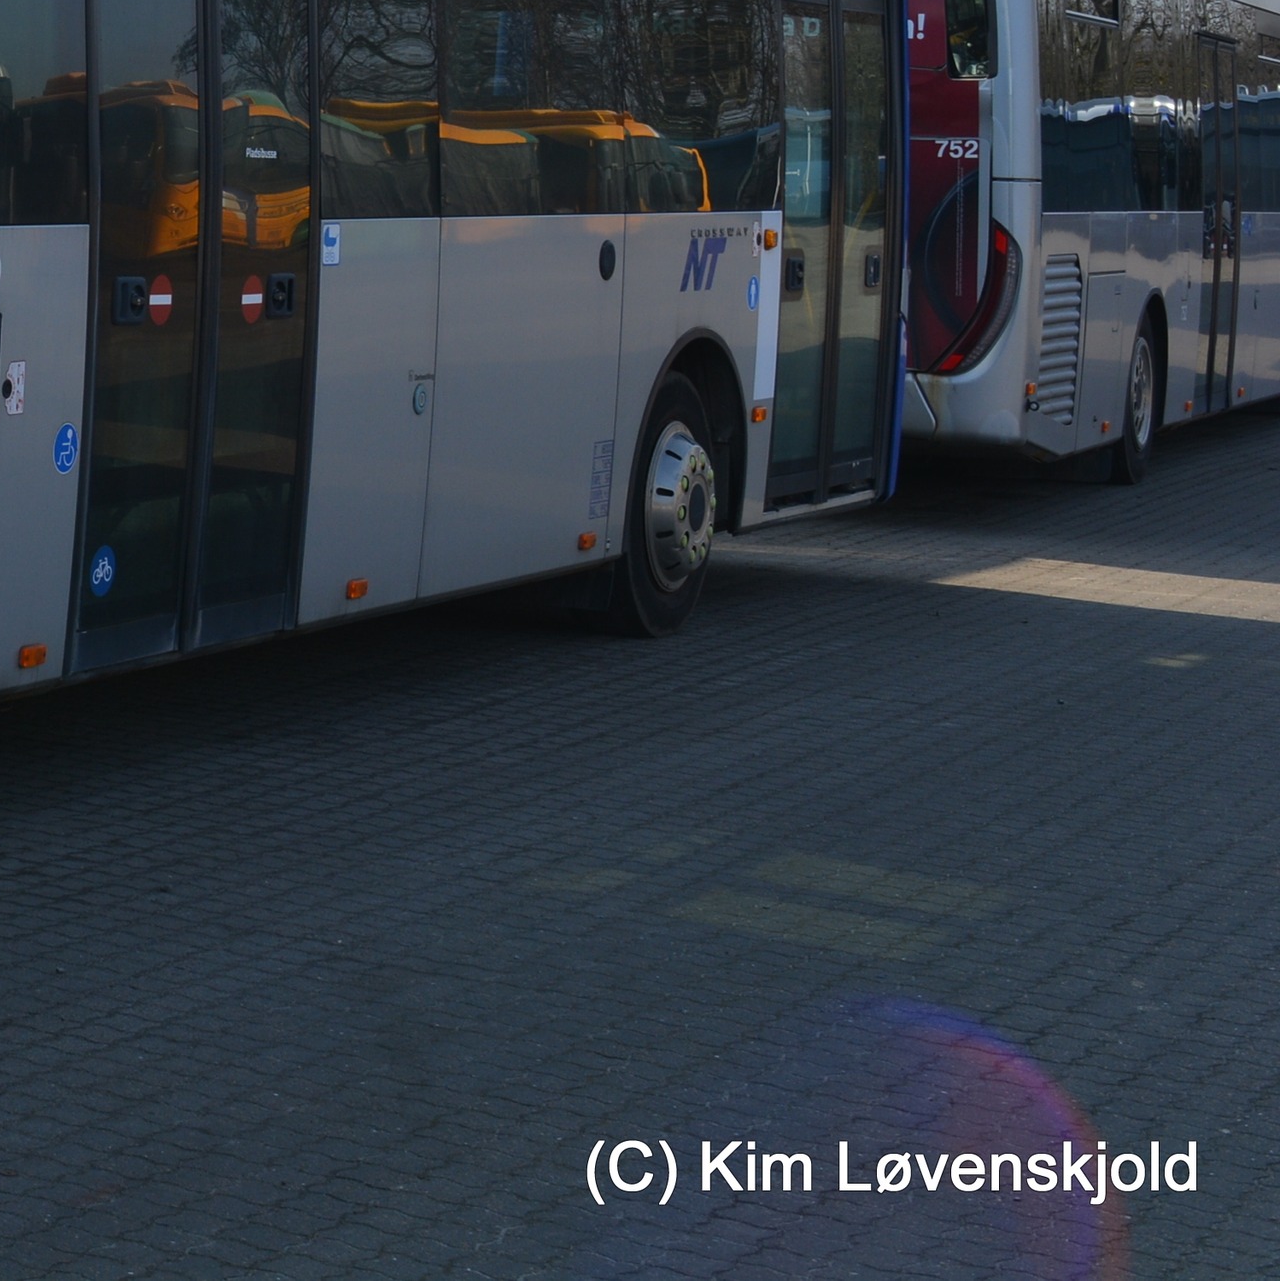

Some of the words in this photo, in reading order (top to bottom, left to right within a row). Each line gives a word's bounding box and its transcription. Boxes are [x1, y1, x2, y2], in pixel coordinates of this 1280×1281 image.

[934, 139, 979, 159] 752
[690, 227, 749, 239] CROSSWAY
[680, 237, 727, 292] NT
